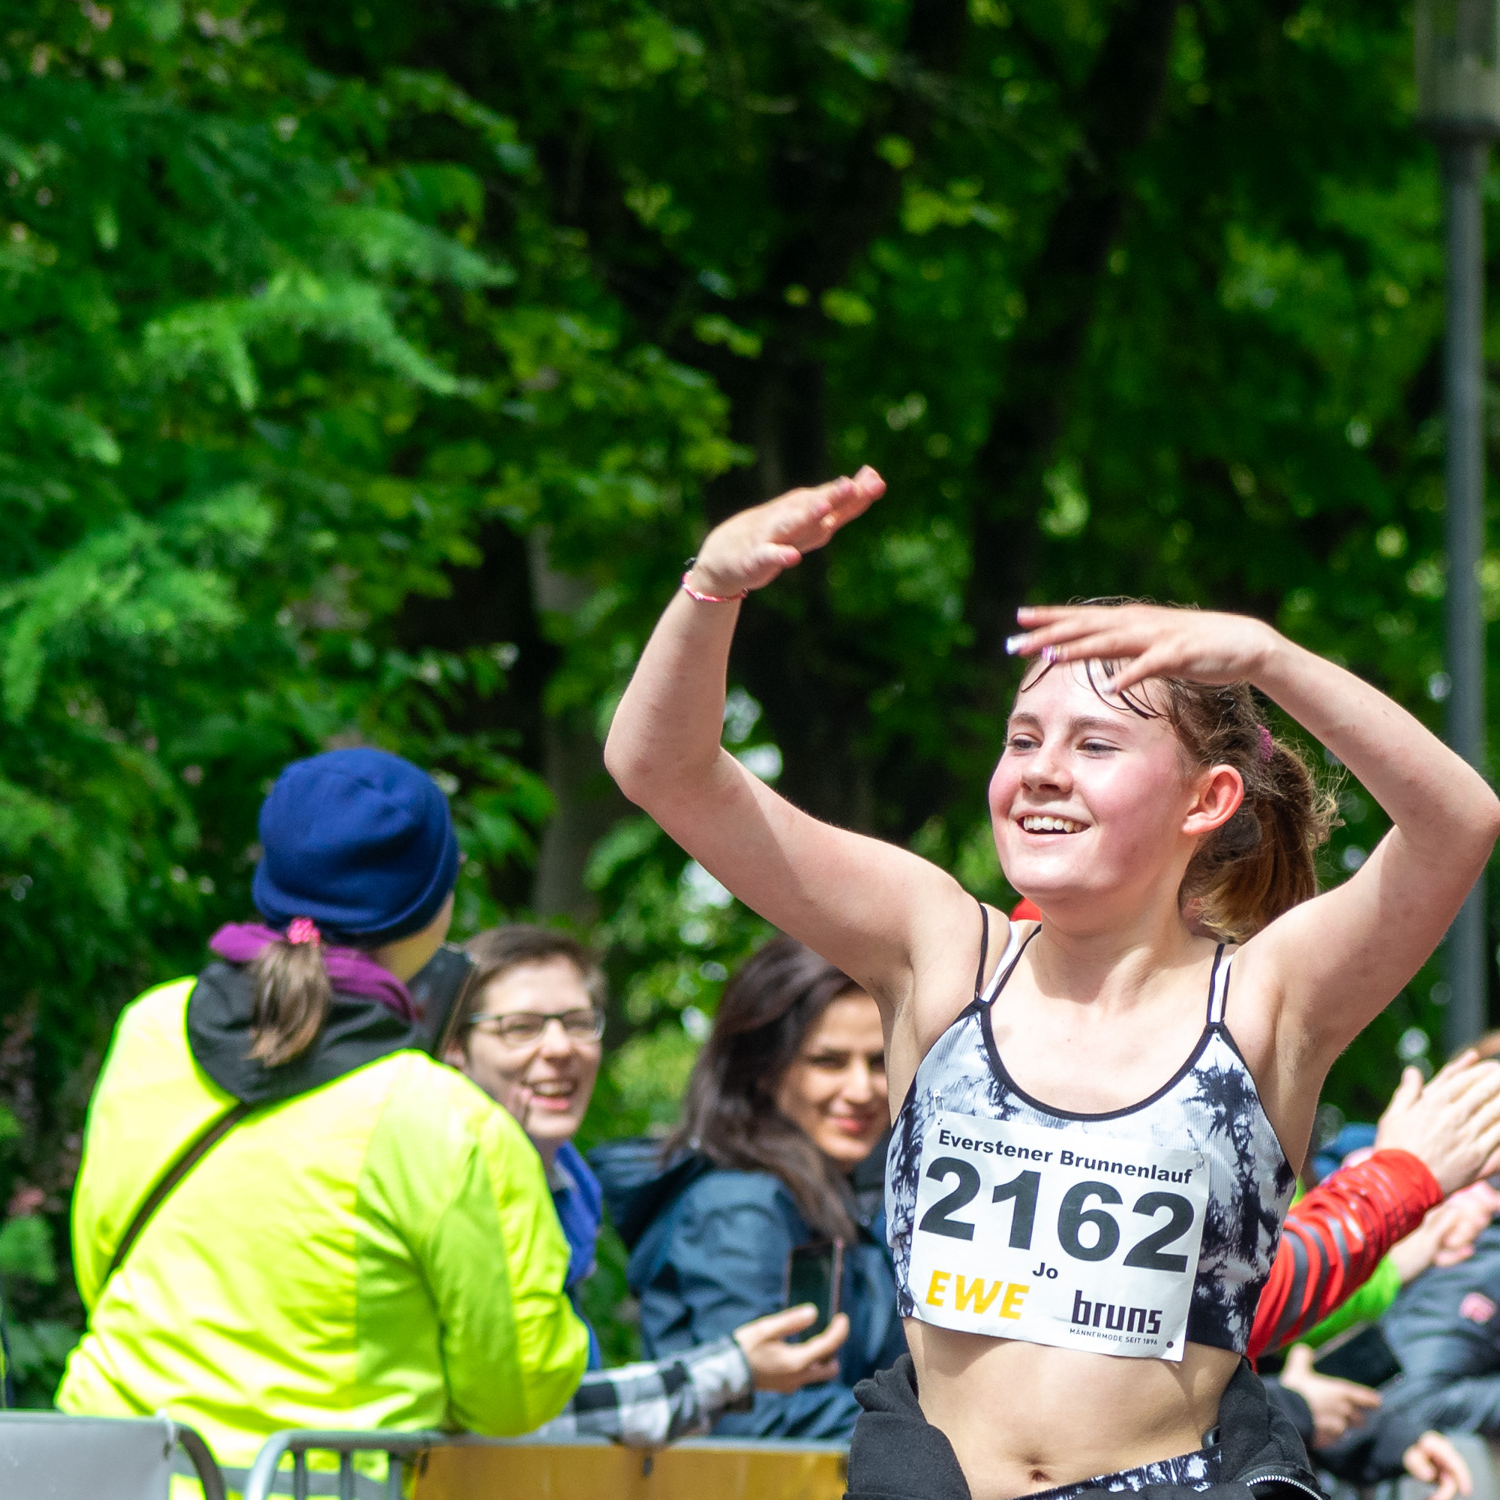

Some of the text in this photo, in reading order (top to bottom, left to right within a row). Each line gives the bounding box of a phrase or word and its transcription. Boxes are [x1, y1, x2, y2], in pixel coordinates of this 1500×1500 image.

[938, 1129, 1193, 1185] Everstener Brunnenlauf
[918, 1155, 1195, 1273] 2162
[925, 1269, 1030, 1320] EWE
[1032, 1262, 1059, 1280] Jo
[1071, 1289, 1163, 1335] bruns
[1125, 1336, 1142, 1345] SEIT
